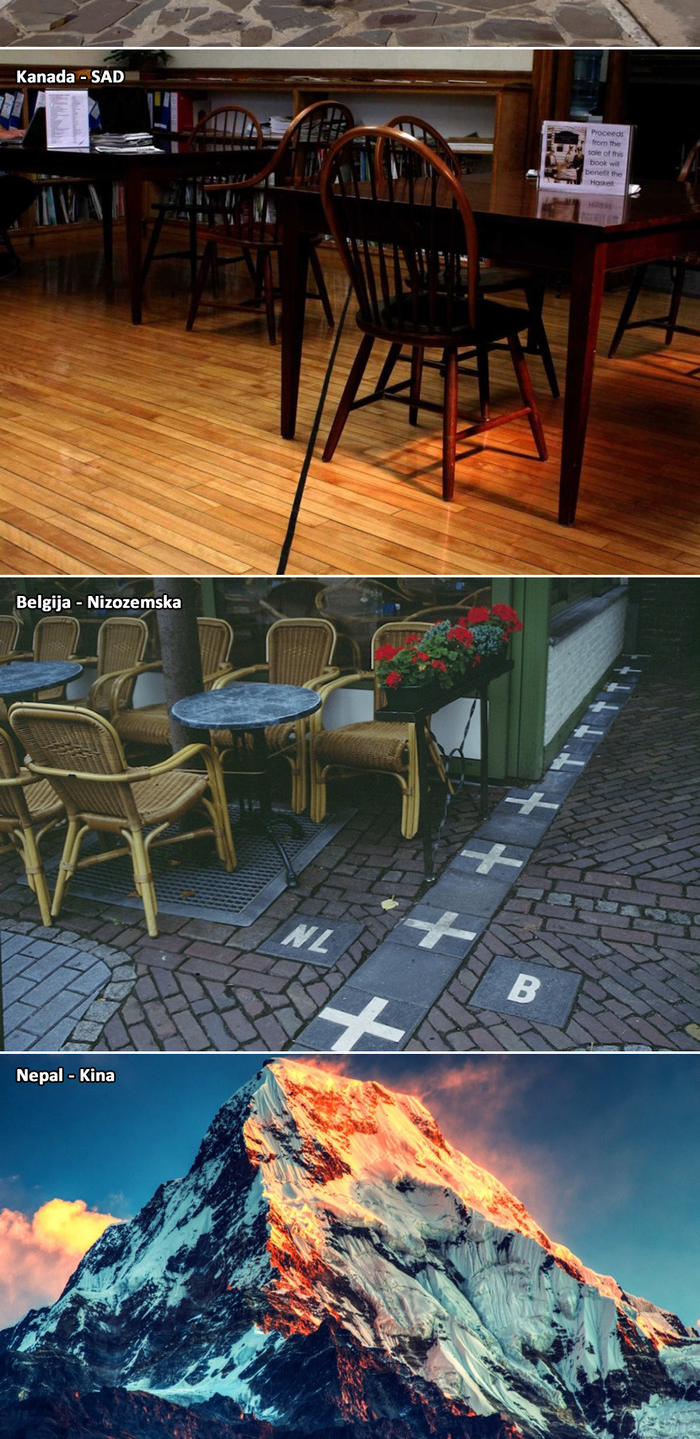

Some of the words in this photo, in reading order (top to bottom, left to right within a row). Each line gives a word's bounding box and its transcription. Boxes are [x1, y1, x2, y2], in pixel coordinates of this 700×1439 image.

[591, 129, 624, 138] Proceeds
[590, 159, 608, 167] book
[611, 170, 623, 178] the
[280, 923, 334, 954] NL
[506, 973, 541, 1004] B
